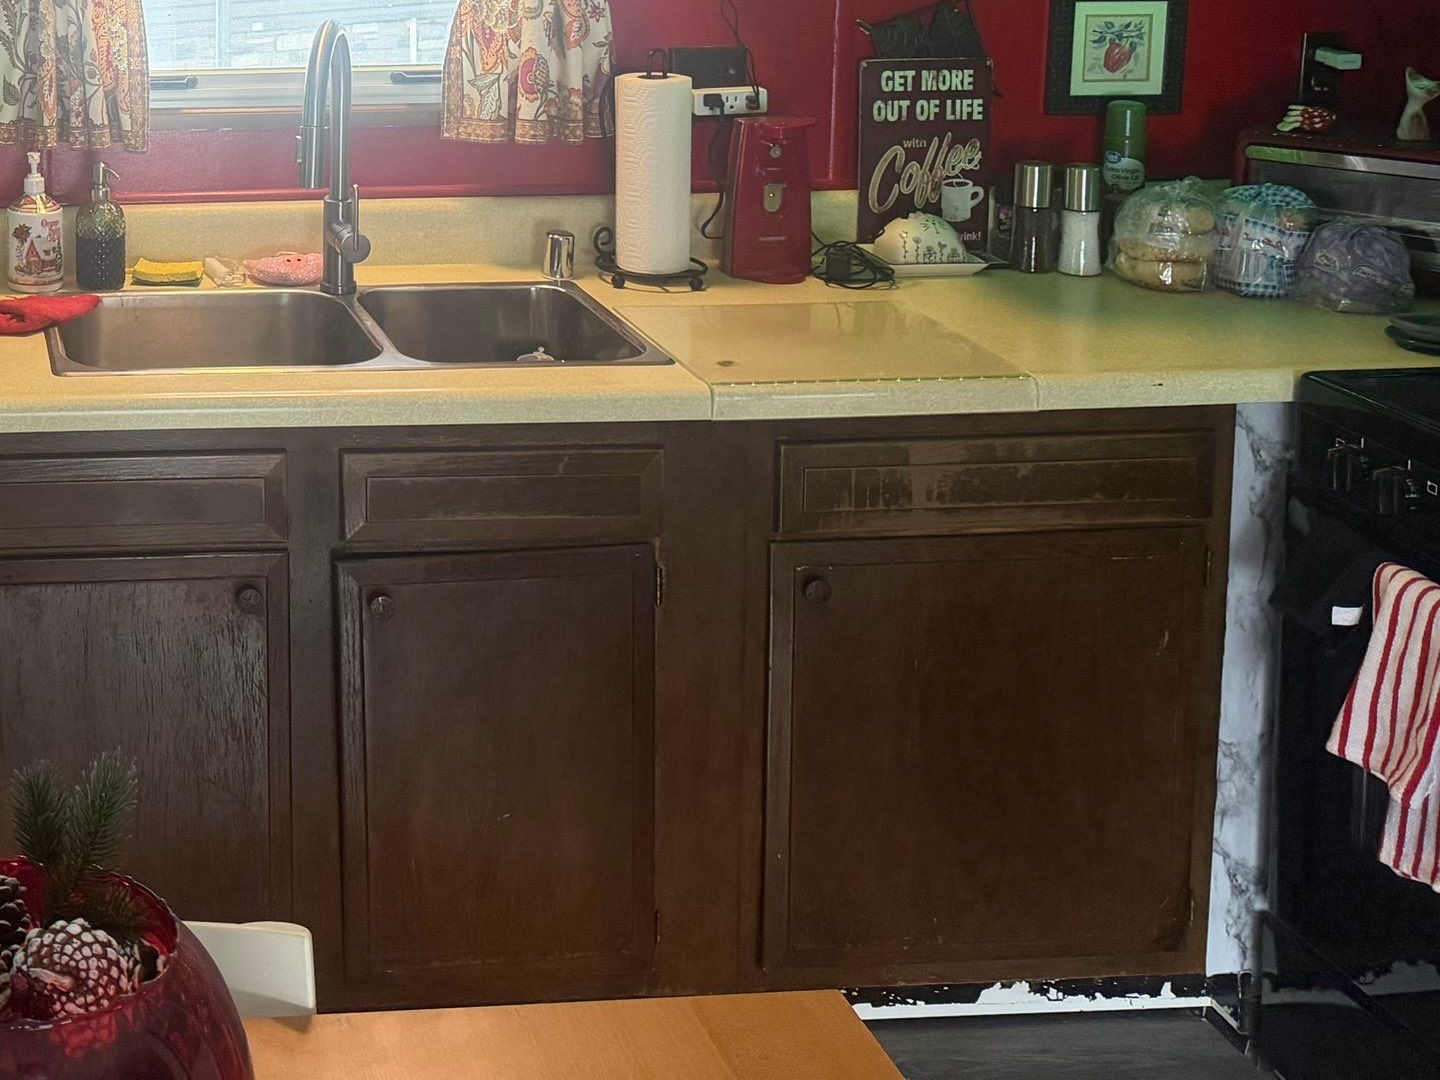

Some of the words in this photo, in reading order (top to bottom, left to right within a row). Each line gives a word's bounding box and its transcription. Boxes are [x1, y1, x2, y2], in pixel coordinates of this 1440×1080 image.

[880, 70, 916, 92] GET
[921, 69, 974, 92] MORE
[872, 99, 911, 122] OUT
[915, 99, 940, 121] OF
[946, 98, 984, 120] LIFE
[868, 131, 983, 214] Coffee
